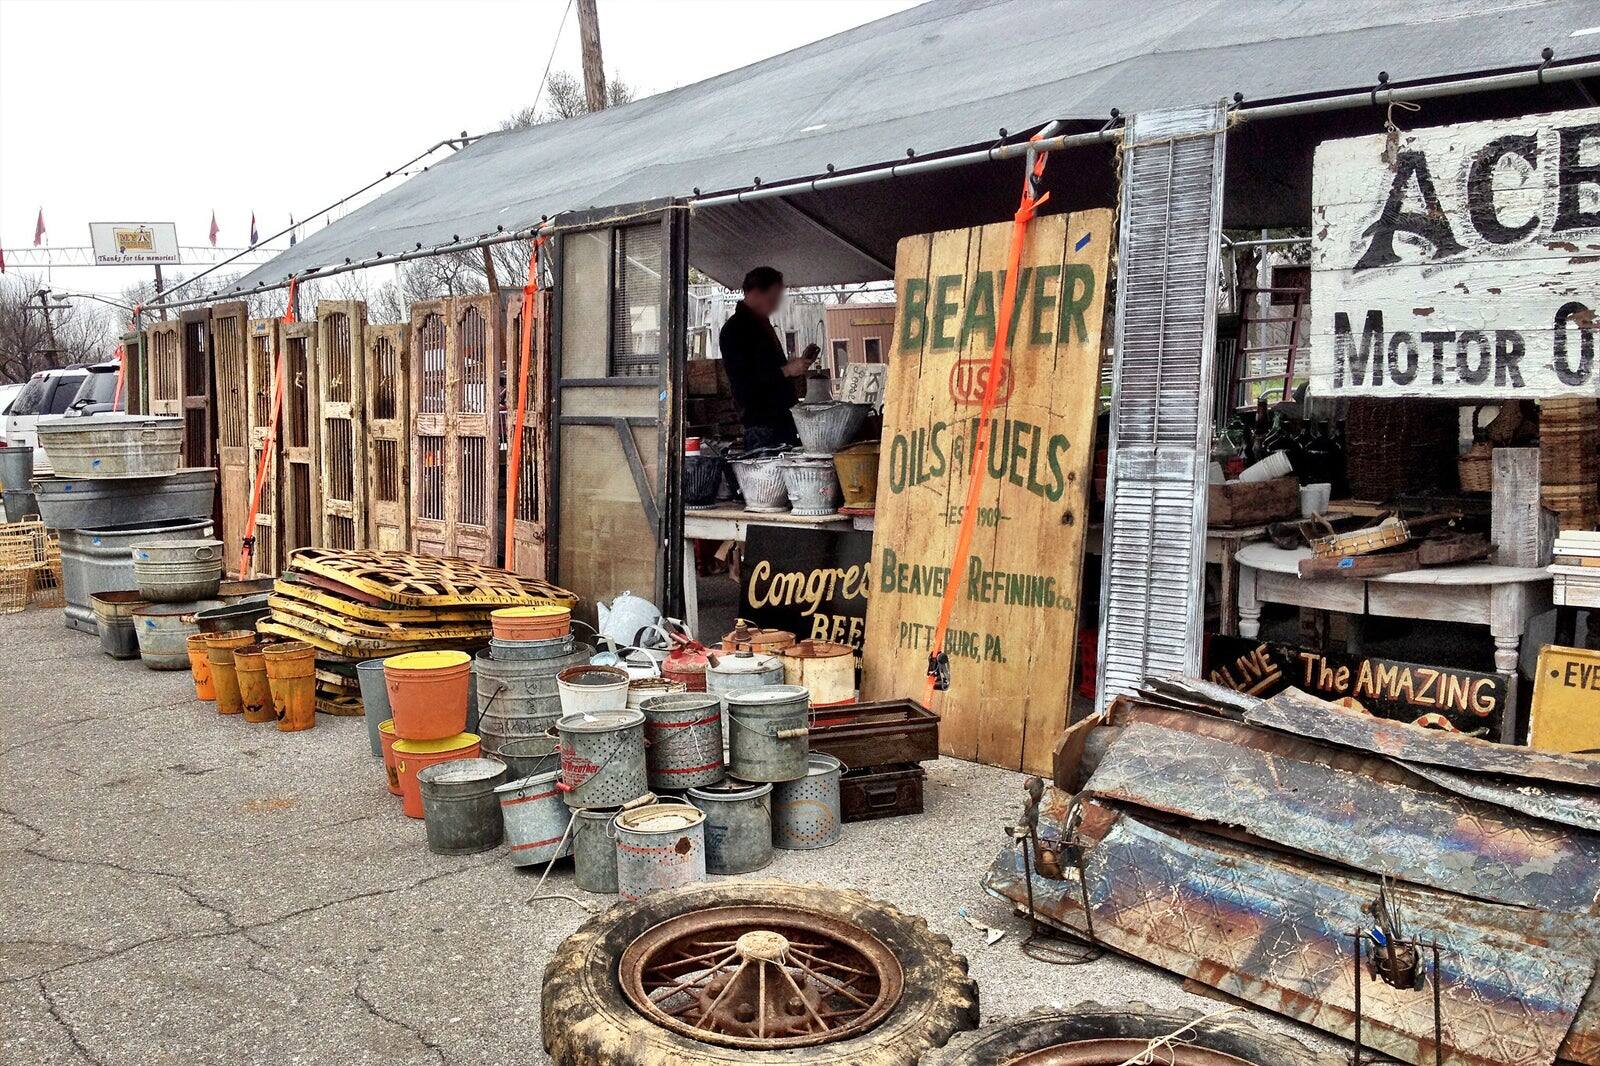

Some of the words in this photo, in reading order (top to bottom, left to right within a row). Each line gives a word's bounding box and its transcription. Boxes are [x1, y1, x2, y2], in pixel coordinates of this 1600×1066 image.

[97, 255, 121, 263] Thanks
[122, 255, 134, 263] for
[900, 263, 1096, 353] BEAVER
[1333, 309, 1526, 388] MOTOR
[889, 421, 947, 494] OILS
[968, 418, 1071, 501] FUELS
[967, 555, 1056, 608] REFINING
[810, 613, 865, 650] BEE
[899, 621, 981, 663] PITTBURG,
[984, 633, 1007, 663] PA.
[1298, 652, 1350, 691] The
[1353, 659, 1496, 716] AMAZING
